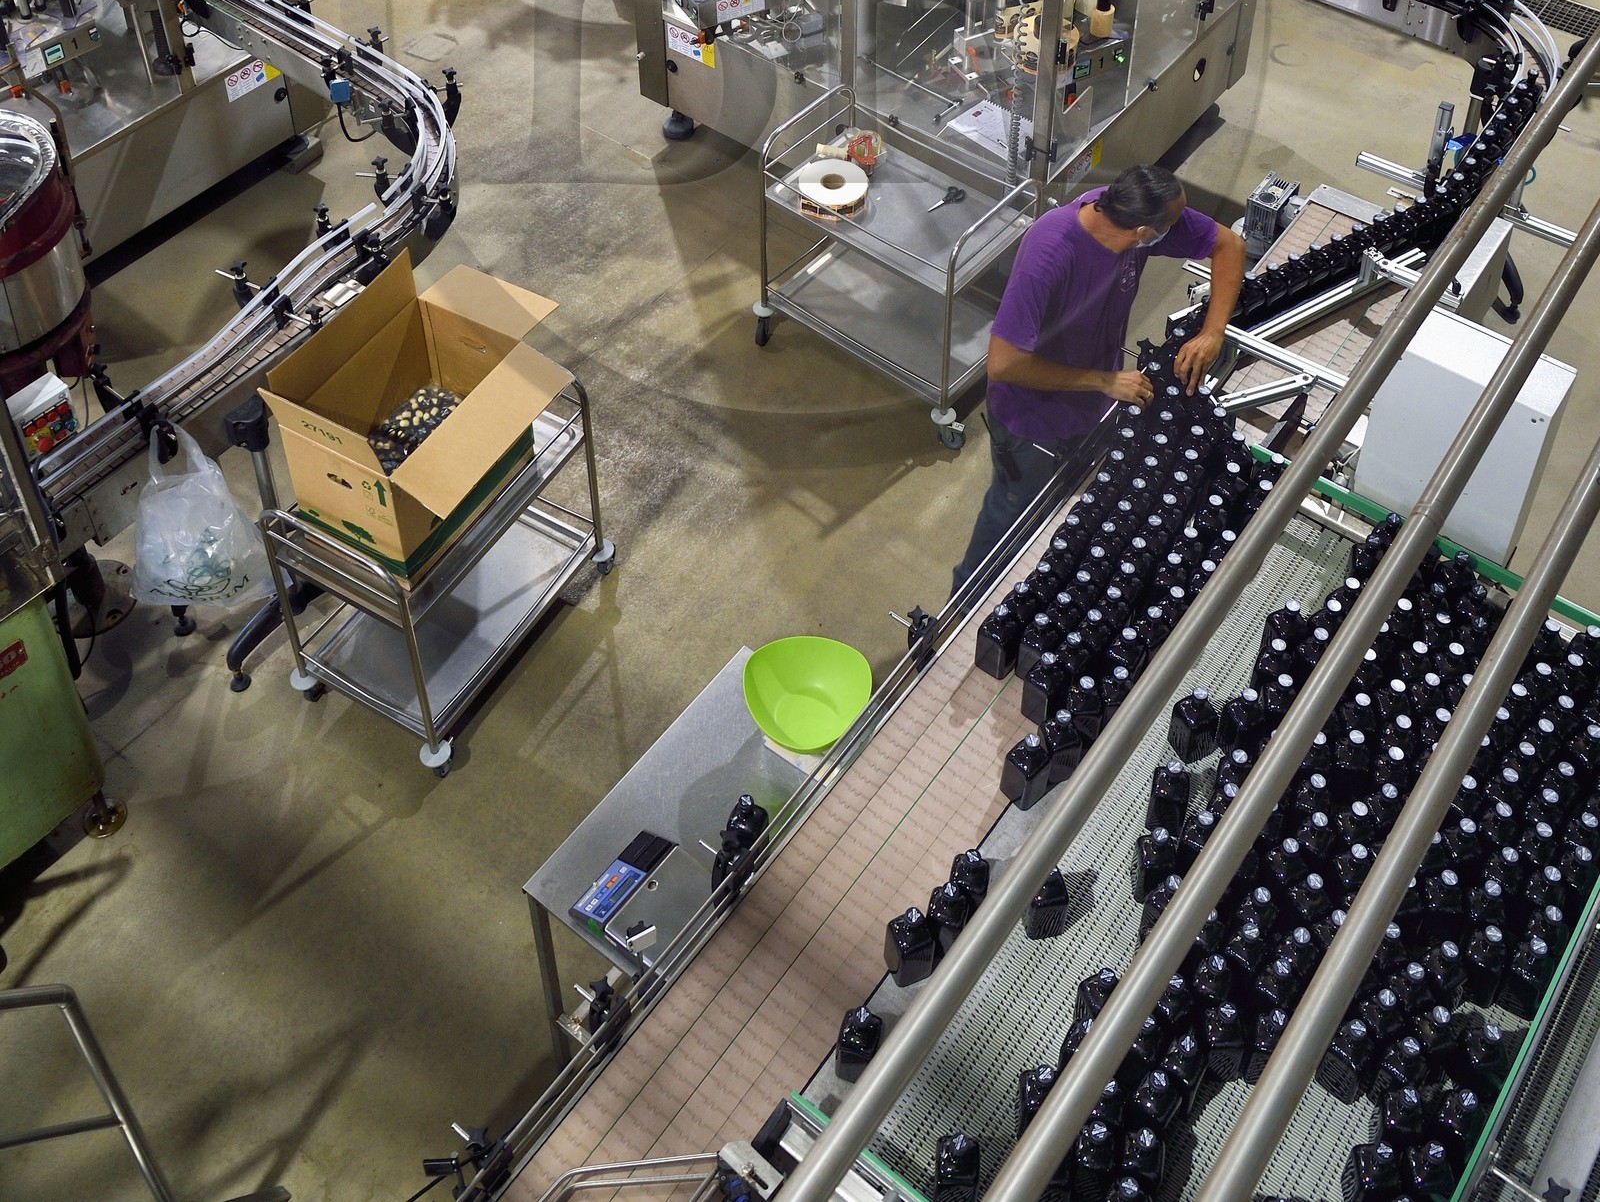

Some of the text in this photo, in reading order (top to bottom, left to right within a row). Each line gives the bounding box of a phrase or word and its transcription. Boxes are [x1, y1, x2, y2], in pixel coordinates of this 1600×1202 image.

[71, 37, 79, 49] 1
[1098, 56, 1104, 69] 1
[301, 420, 343, 445] 27191
